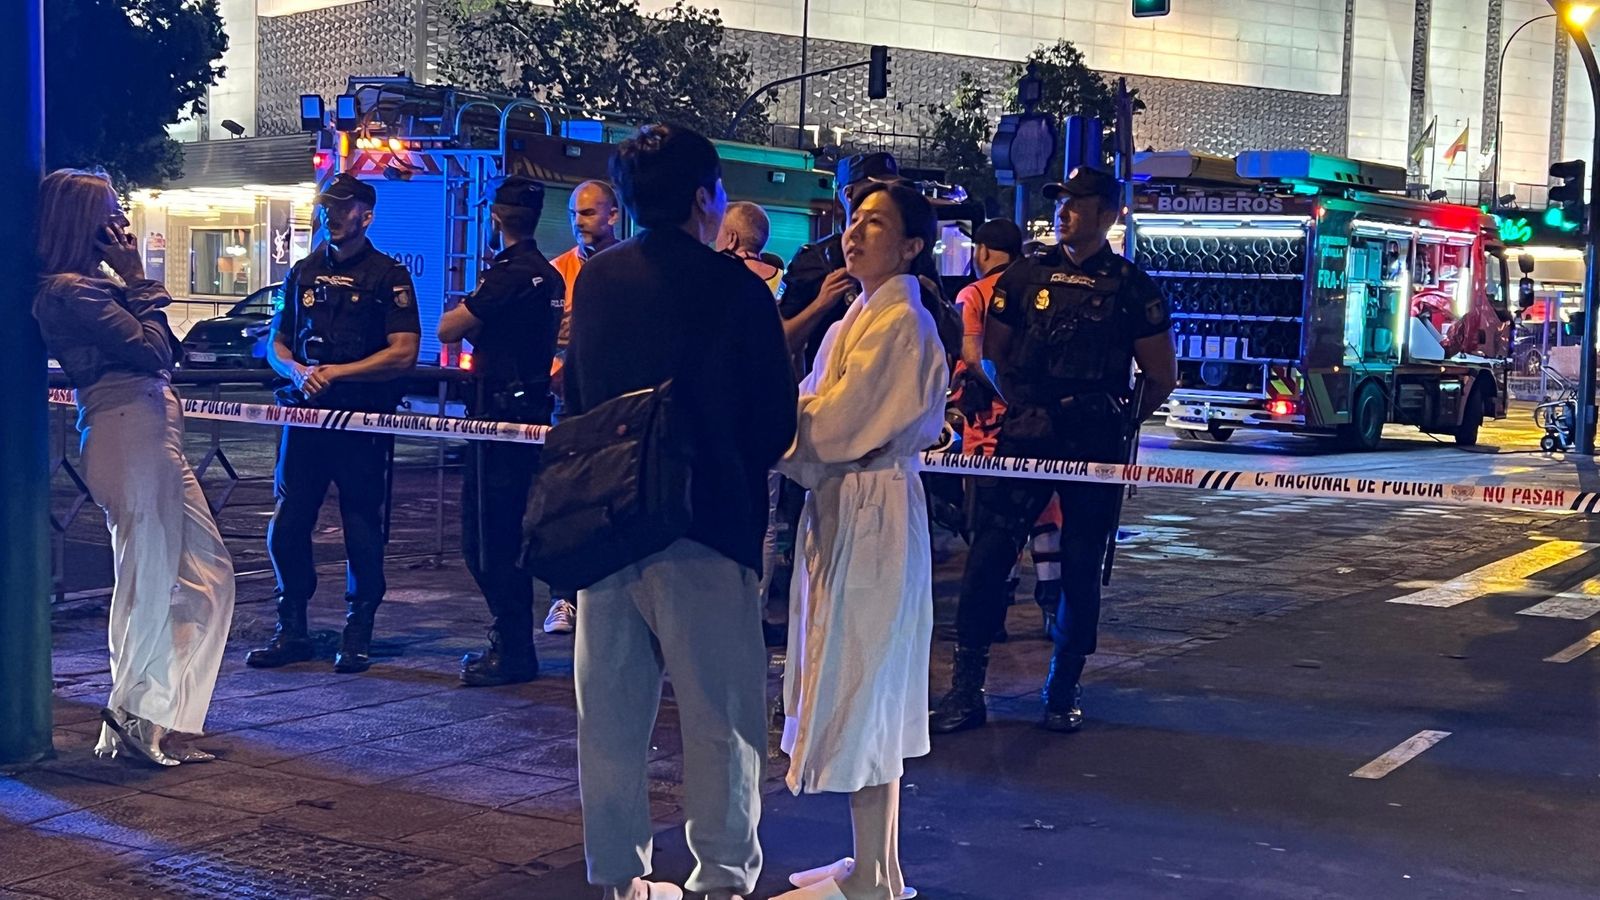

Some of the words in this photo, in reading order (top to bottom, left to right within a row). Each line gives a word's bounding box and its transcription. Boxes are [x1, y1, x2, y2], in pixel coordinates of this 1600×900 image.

[1157, 196, 1284, 213] BOMBEROS
[1317, 269, 1345, 290] FRA-1
[184, 399, 198, 413] DE
[265, 405, 282, 421] NO
[284, 407, 320, 424] PASAR
[377, 414, 432, 431] NACIONAL
[435, 417, 450, 432] DE
[453, 419, 498, 436] POLICIA
[524, 426, 542, 441] NO
[941, 453, 1008, 471] NACIONAL
[1012, 457, 1030, 473] DE
[1034, 459, 1088, 476] POLICIA
[1121, 463, 1143, 482] NO
[1146, 465, 1195, 485] PASAR
[1274, 473, 1351, 492] NACIONAL
[1356, 478, 1376, 494] DE
[1381, 480, 1444, 498] POLICIA
[1482, 485, 1506, 504] NO
[1511, 486, 1566, 507] PASAR
